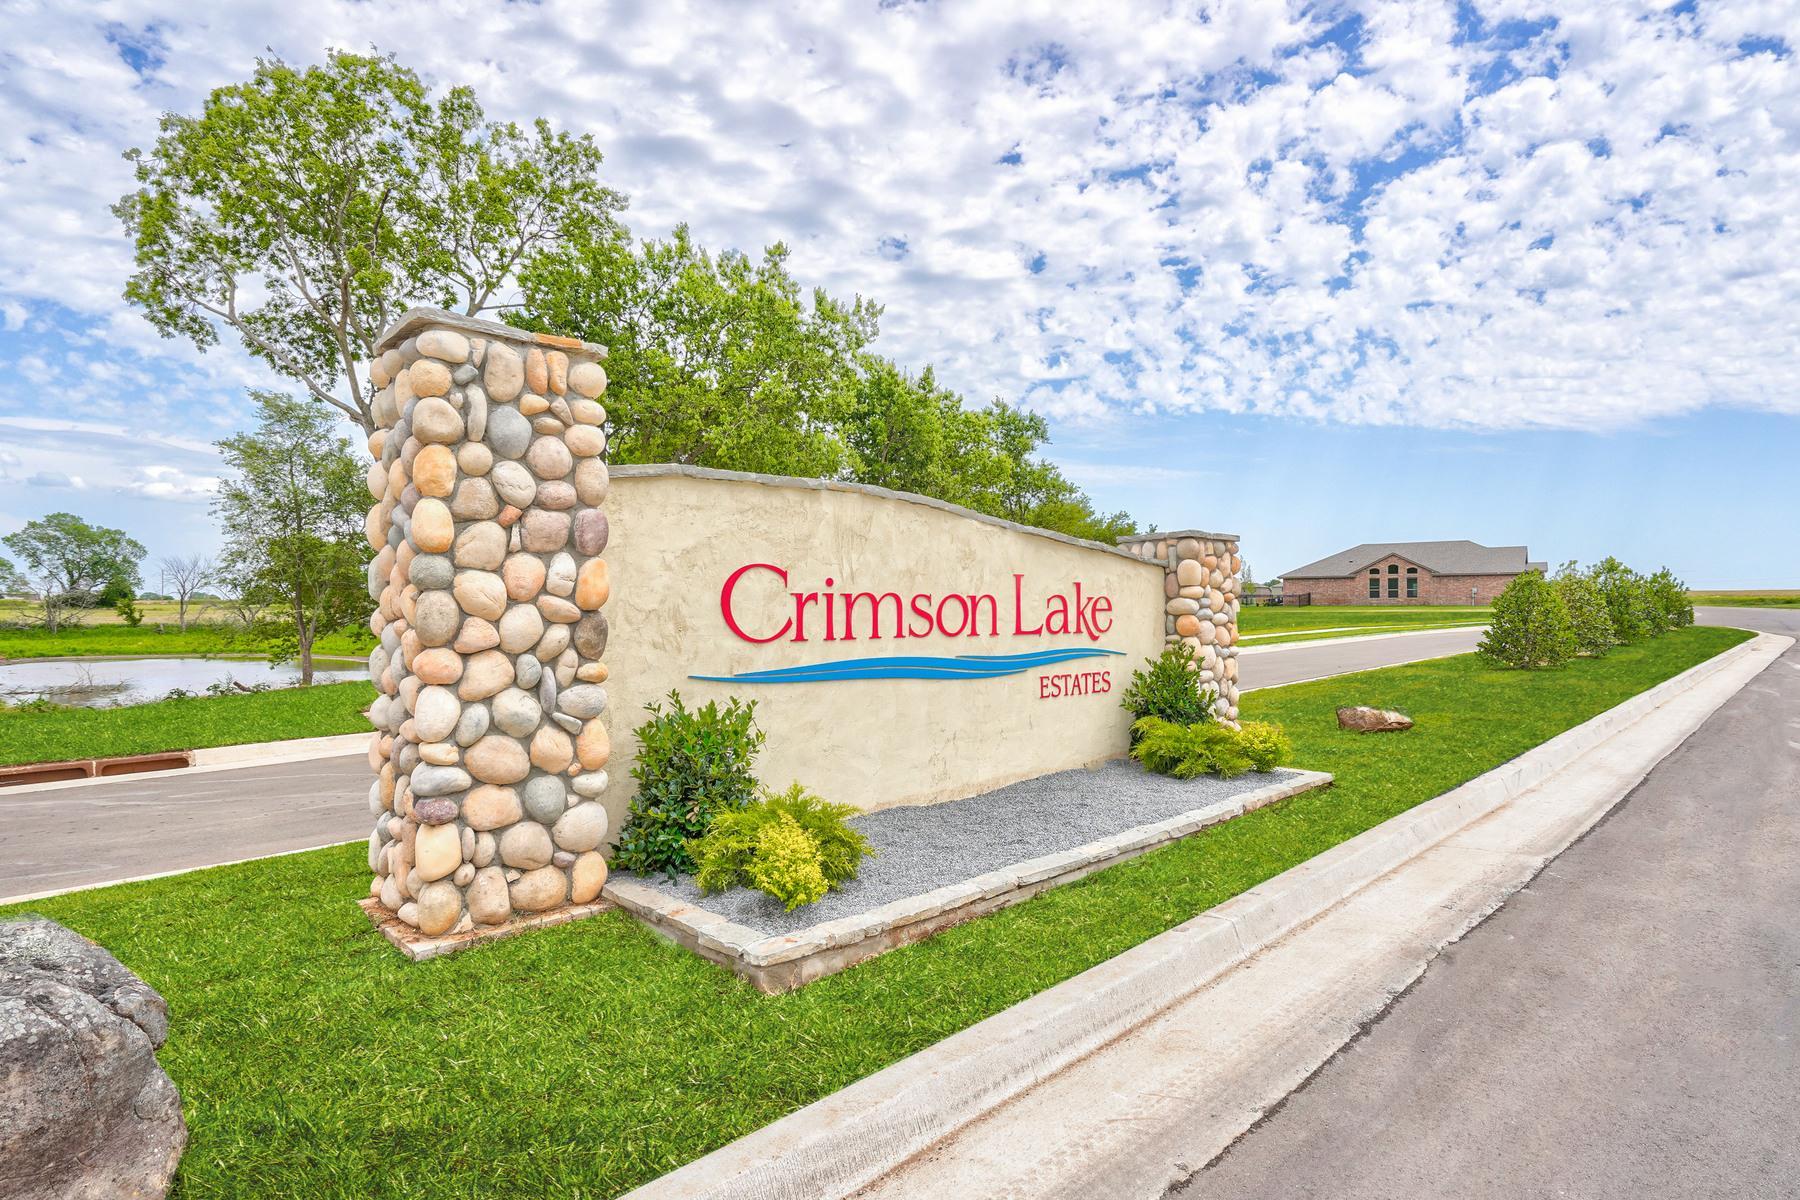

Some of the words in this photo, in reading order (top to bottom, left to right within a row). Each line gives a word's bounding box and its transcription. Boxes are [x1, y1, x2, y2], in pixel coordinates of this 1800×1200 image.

[720, 563, 1000, 644] Crimson
[1013, 573, 1113, 641] Lake
[1039, 671, 1111, 699] ESTATES
